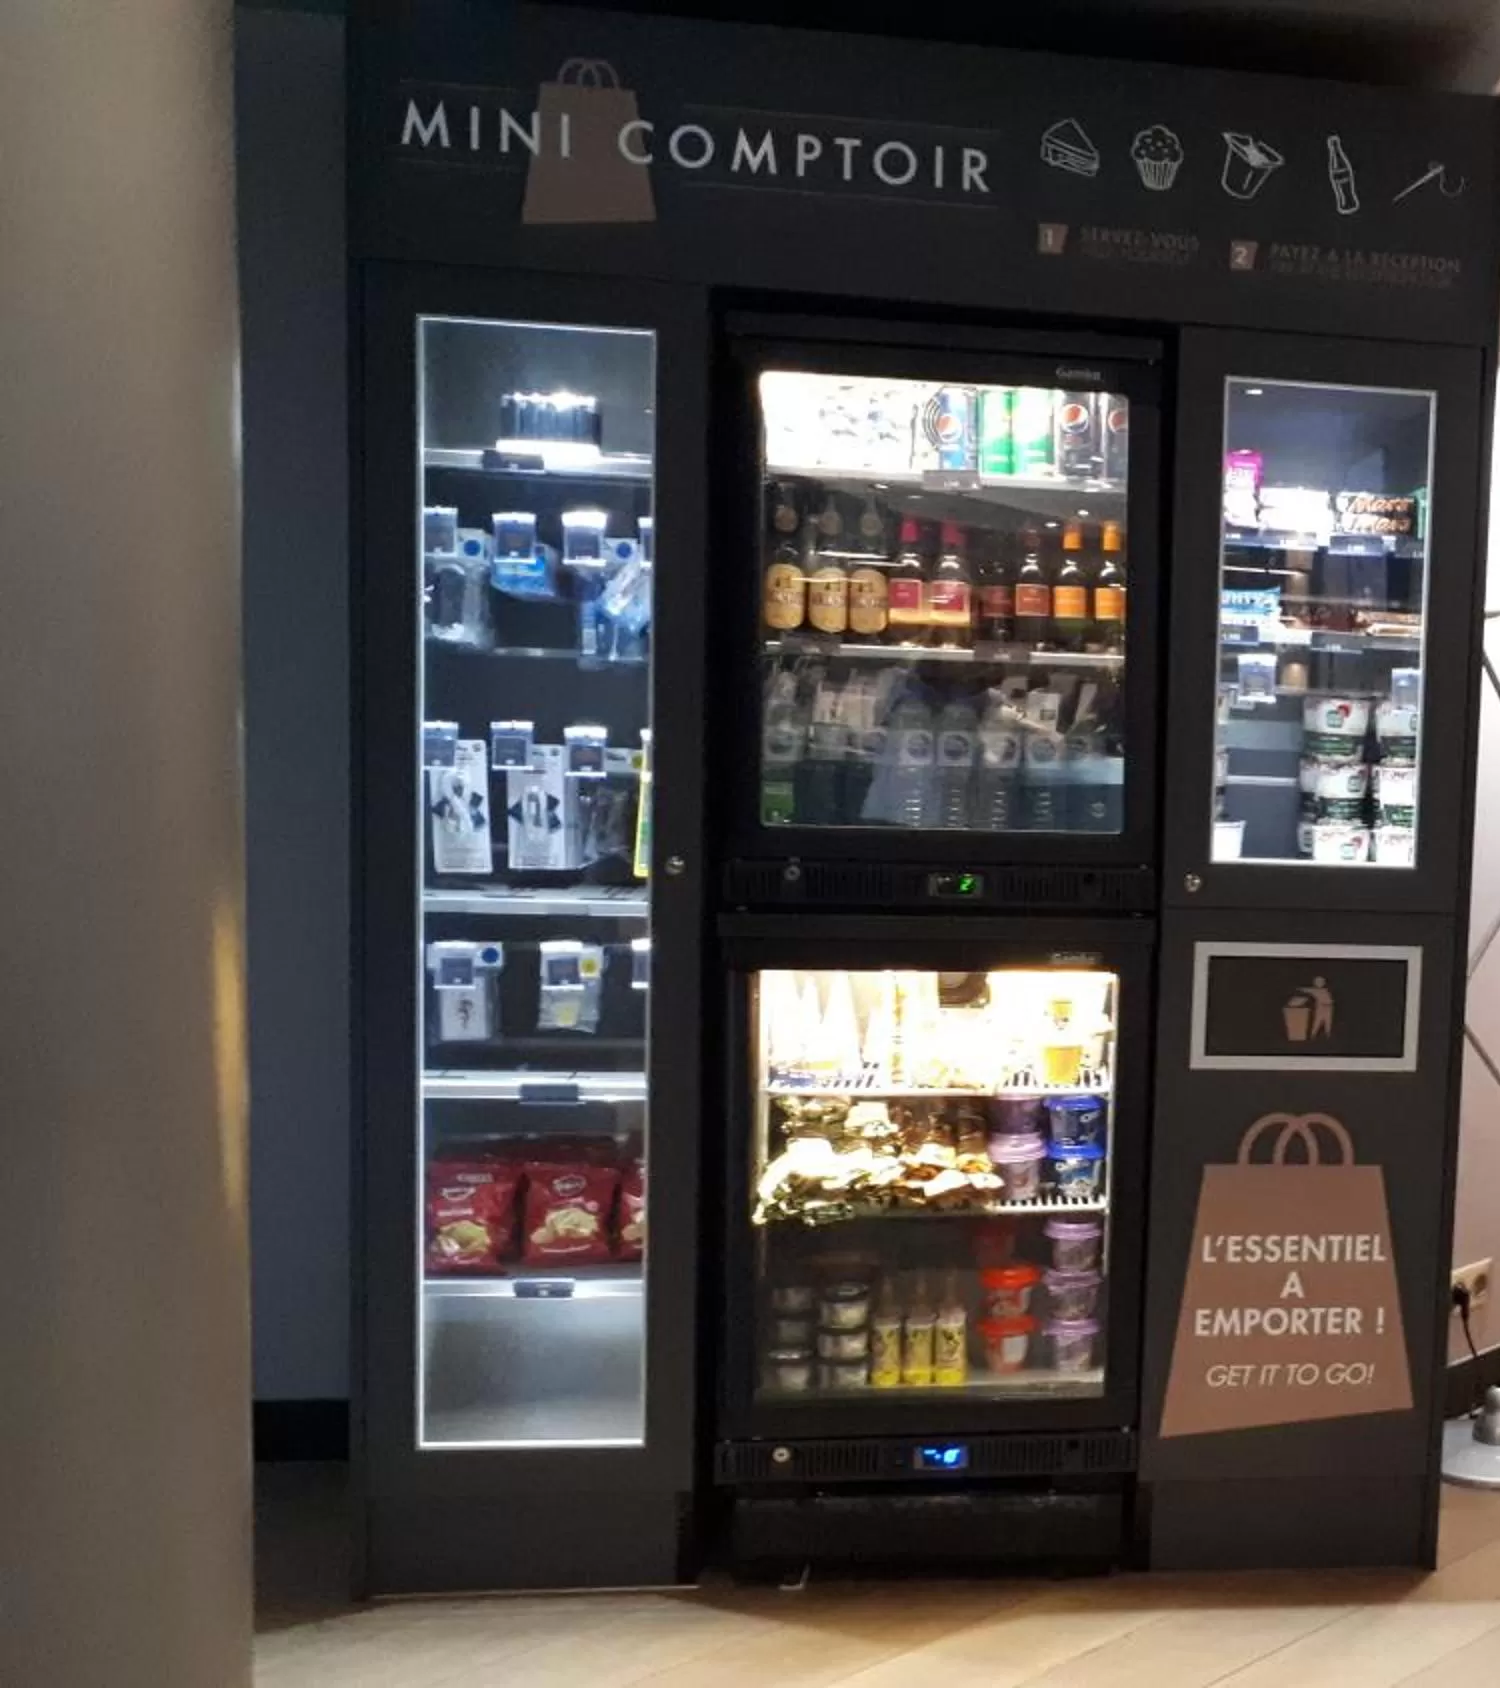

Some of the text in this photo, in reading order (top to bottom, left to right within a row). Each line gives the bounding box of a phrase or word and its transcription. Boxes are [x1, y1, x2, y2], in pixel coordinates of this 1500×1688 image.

[400, 98, 990, 193] MINI COMPTOIR
[1202, 1234, 1387, 1264] L'ESSENTIEL
[1280, 1271, 1305, 1299] A
[1194, 1307, 1363, 1336] EMPORTER
[1206, 1362, 1376, 1387] GET IT TO GO!
